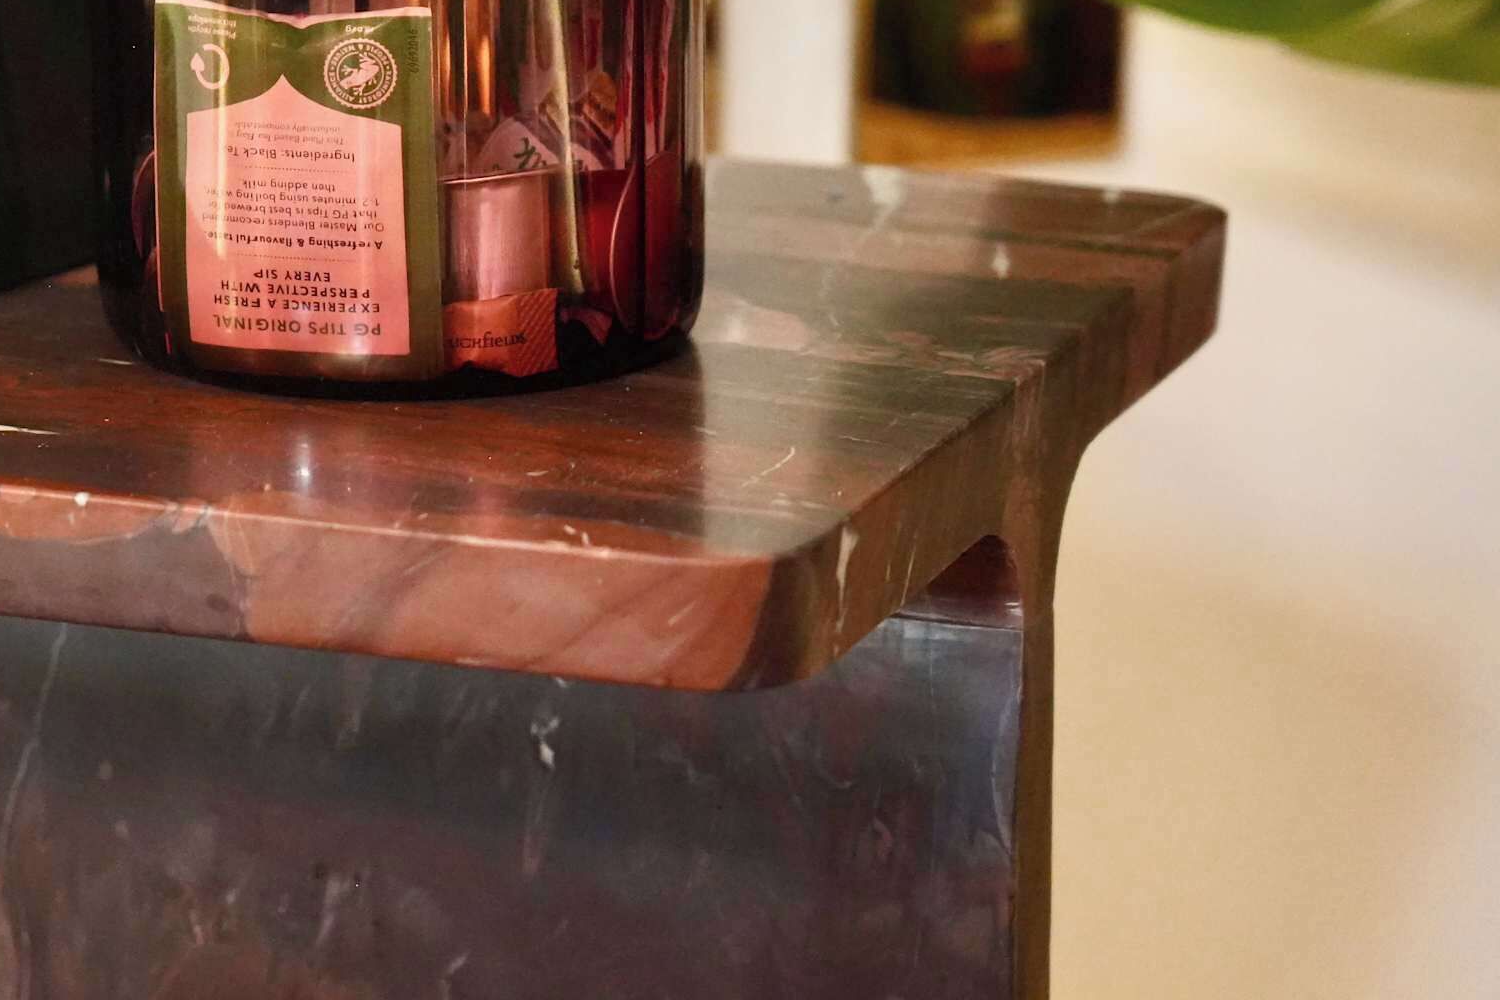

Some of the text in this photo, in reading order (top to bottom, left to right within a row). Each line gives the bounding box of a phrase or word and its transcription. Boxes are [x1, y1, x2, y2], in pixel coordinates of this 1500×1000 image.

[345, 24, 372, 35] .org
[243, 146, 276, 159] Black
[280, 149, 355, 162] Ingredients:
[270, 178, 308, 191] adding
[311, 182, 336, 192] then
[204, 185, 232, 199] wter,
[236, 189, 276, 203] boiling
[280, 191, 308, 202] using
[311, 195, 356, 205] minutes
[224, 202, 266, 214] brewed
[269, 206, 292, 216] best
[296, 207, 304, 216] is
[307, 206, 328, 217] Tips
[332, 209, 348, 218] PG
[352, 210, 376, 219] that
[202, 213, 384, 232] Our Master Blenders recommnd
[204, 231, 383, 250] A refreshing & flavourful tate.
[252, 268, 330, 282] EVERY SIP
[220, 280, 370, 298] PERSPECTIVE WITH
[214, 294, 380, 313] EXPERIENCE A FRESH
[212, 314, 381, 336] PG TIPS ORIGINAL
